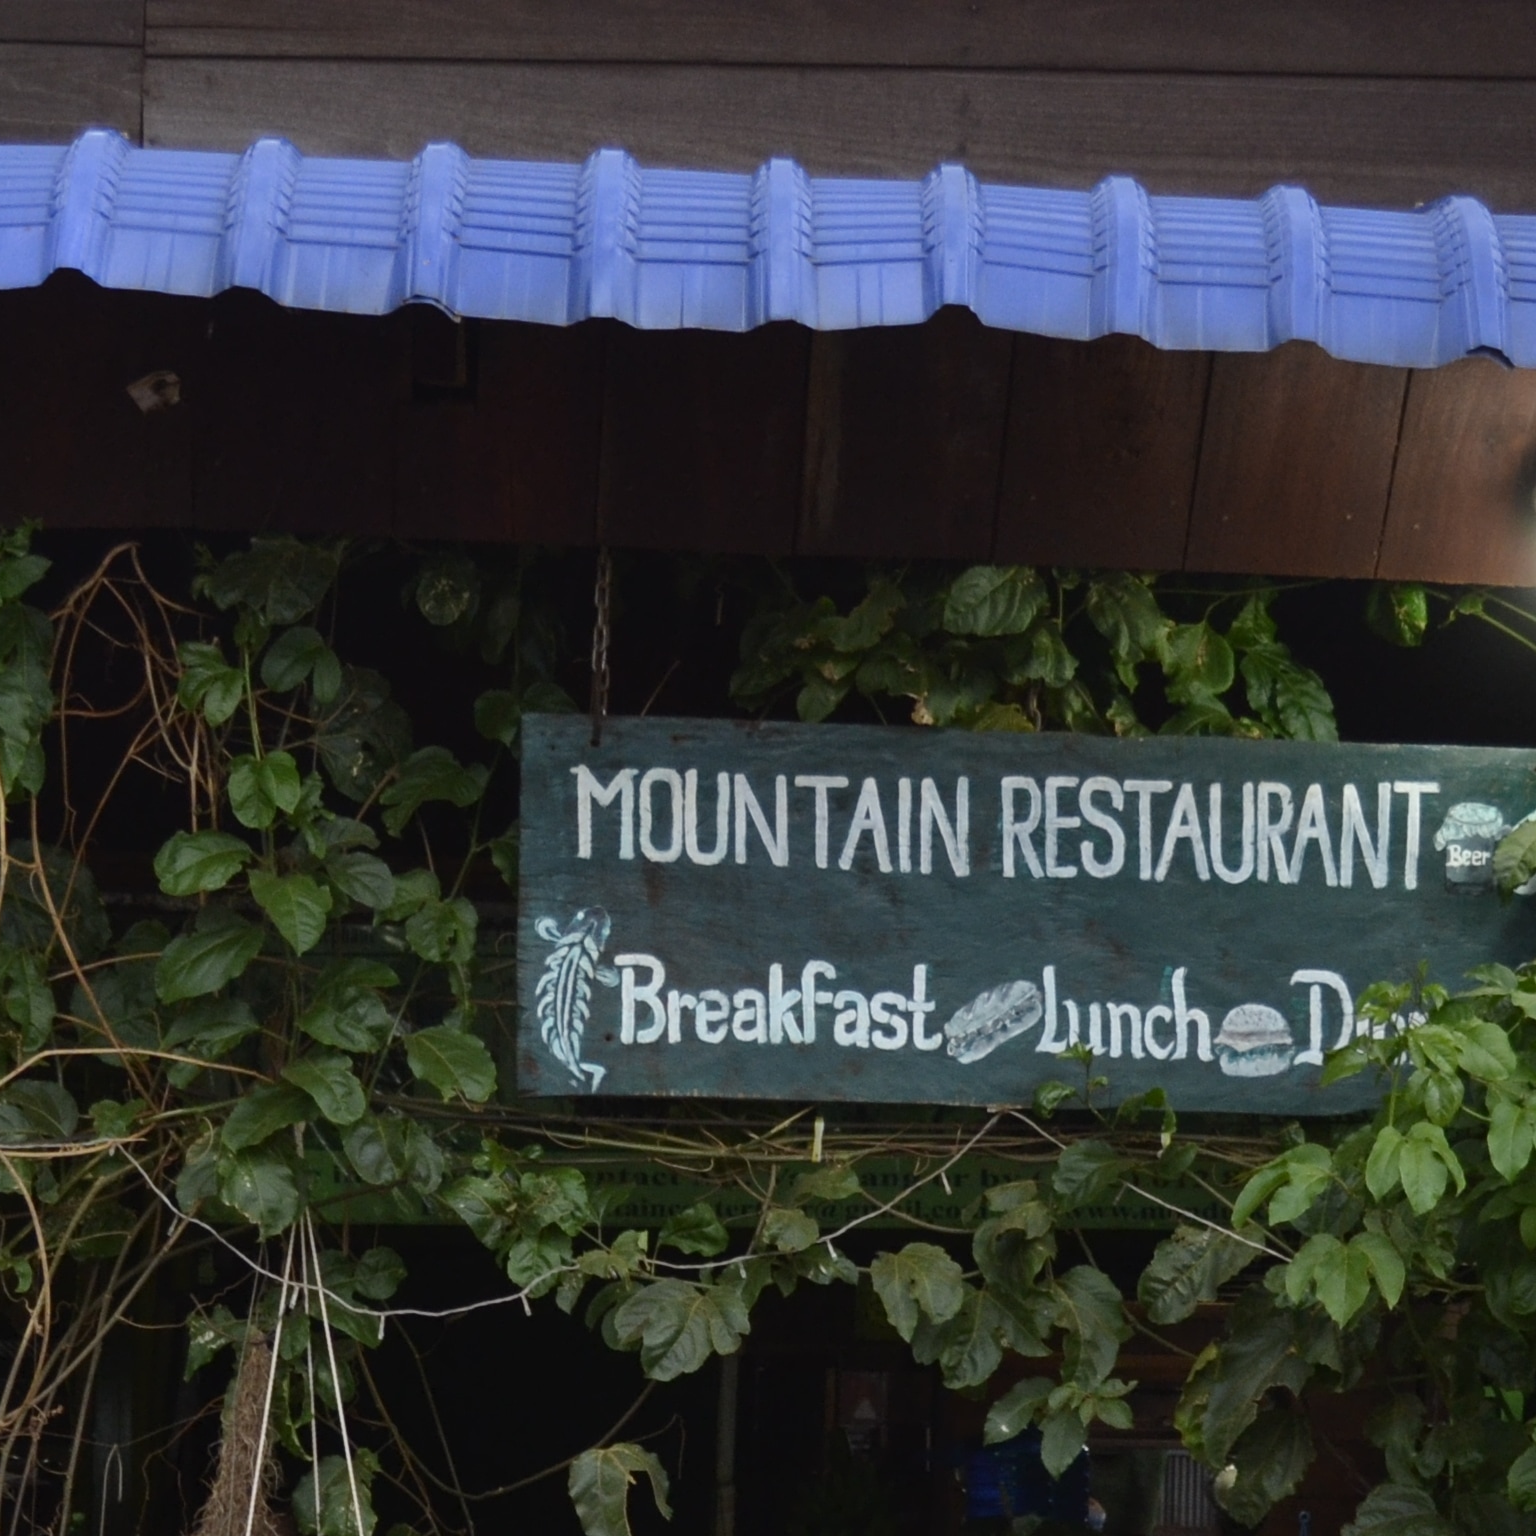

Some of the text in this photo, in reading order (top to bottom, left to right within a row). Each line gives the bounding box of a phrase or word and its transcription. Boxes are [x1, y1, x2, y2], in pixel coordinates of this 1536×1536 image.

[570, 764, 971, 879] MOUNTAIN
[1001, 774, 1441, 891] RESTAURANT
[1446, 843, 1491, 867] Beer
[614, 952, 944, 1052] Breakfast
[1040, 964, 1217, 1063] Lunch
